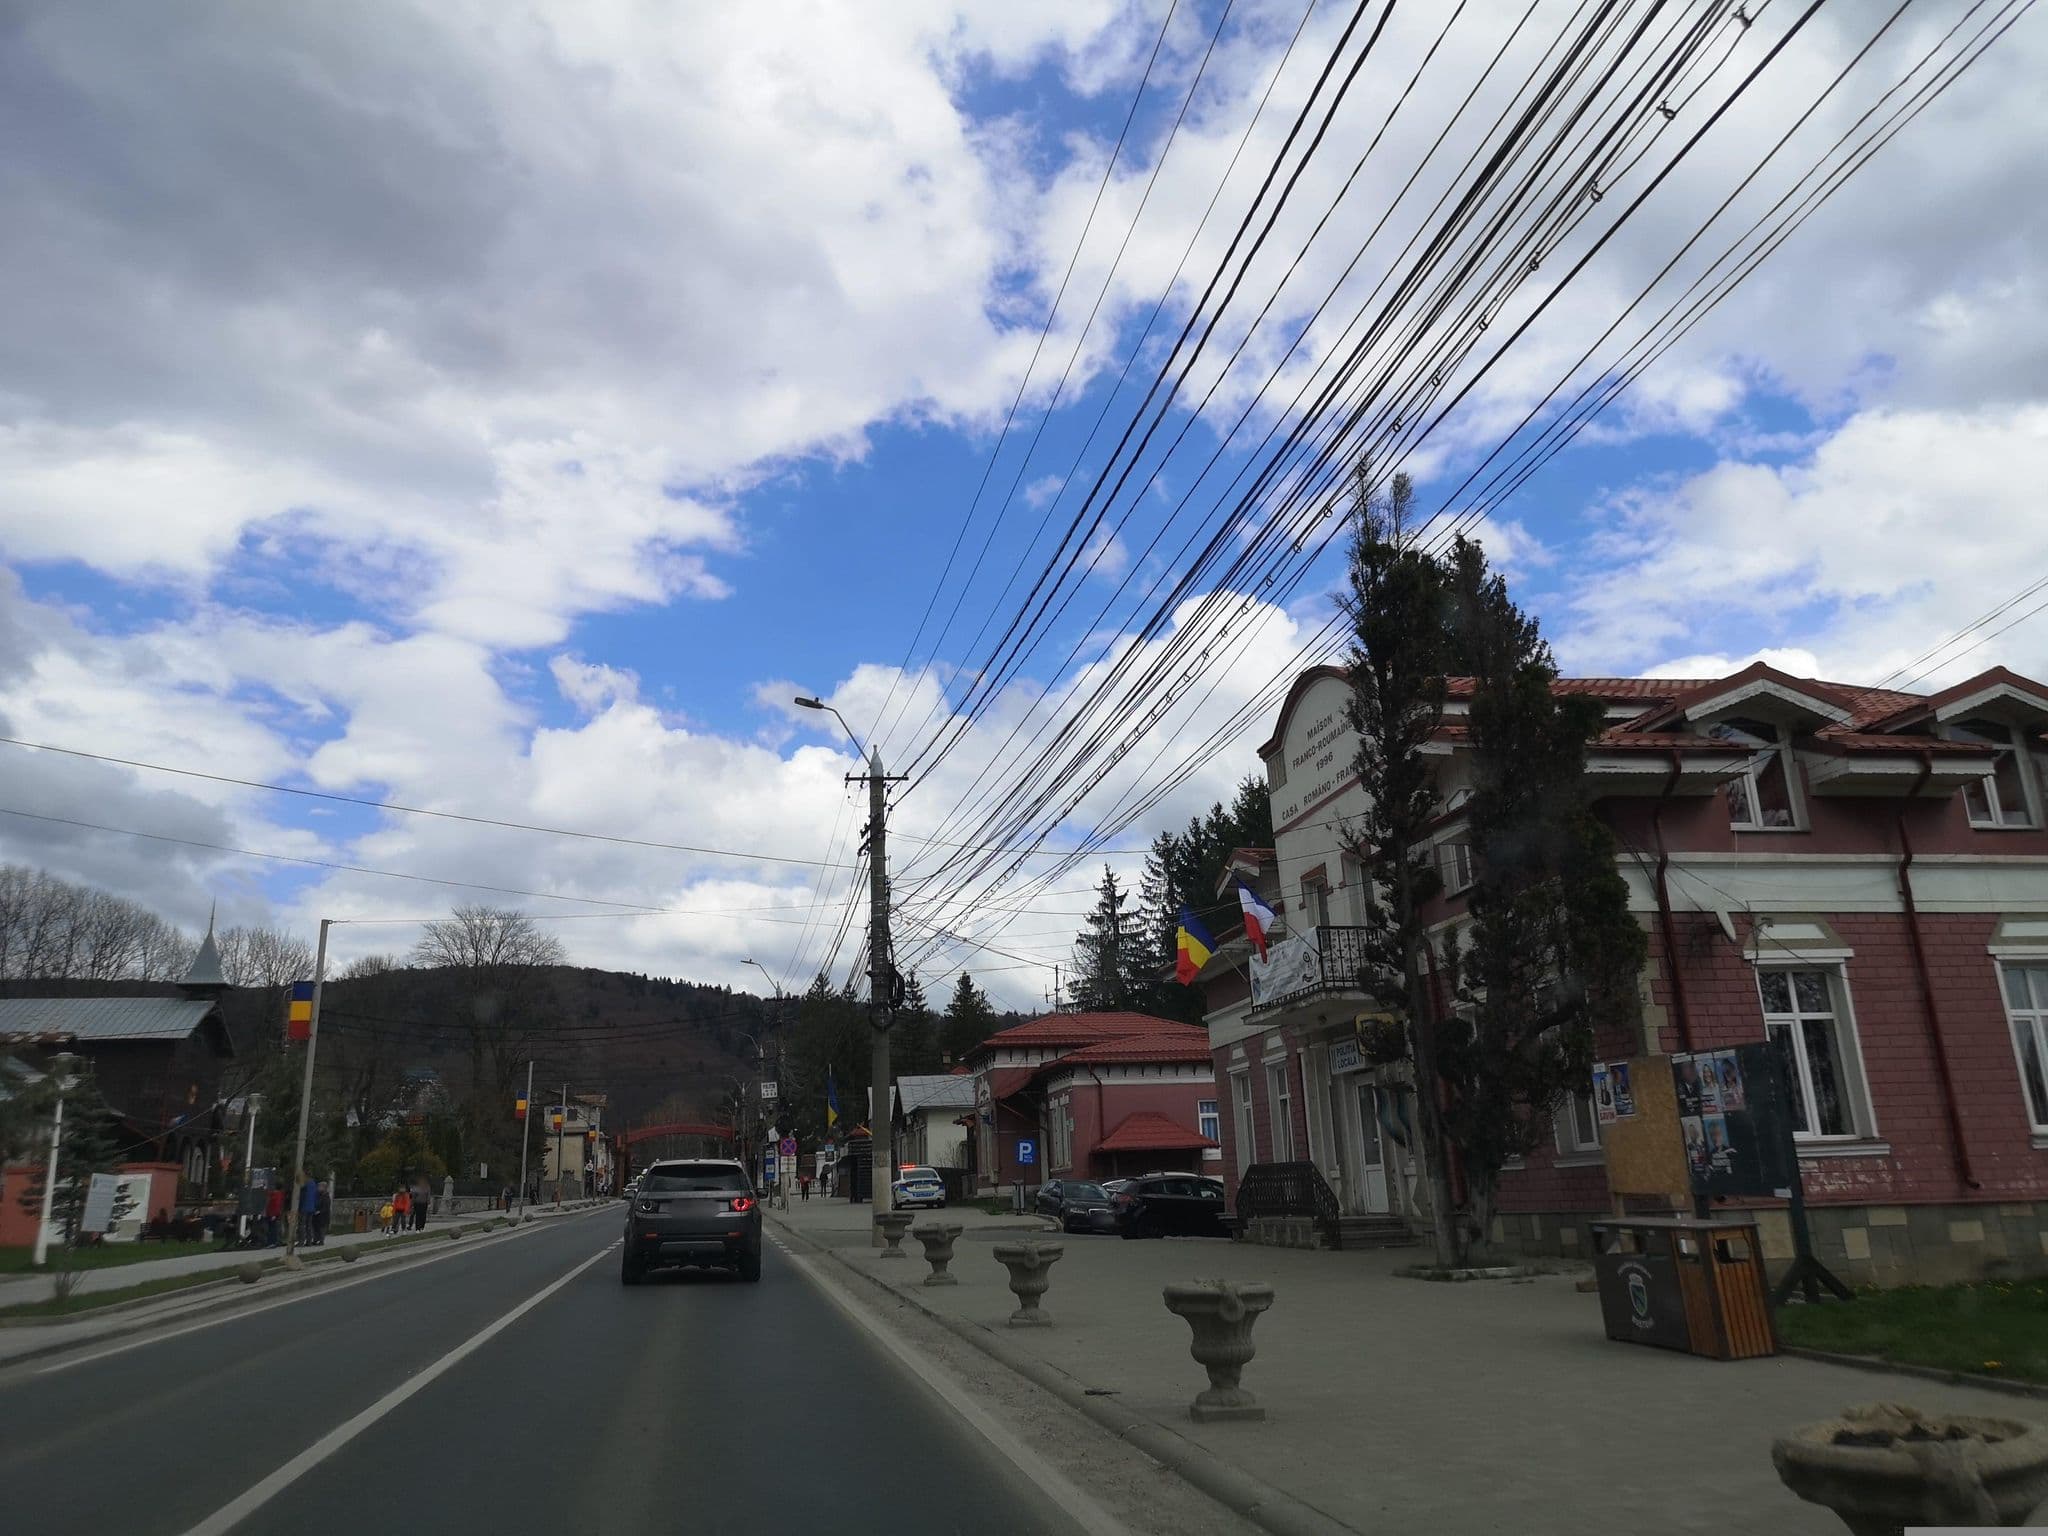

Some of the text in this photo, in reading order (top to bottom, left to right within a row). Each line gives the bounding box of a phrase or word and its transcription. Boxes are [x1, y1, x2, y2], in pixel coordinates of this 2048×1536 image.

[1316, 752, 1334, 771] 1996
[1282, 803, 1299, 821] CASA
[1019, 1142, 1032, 1162] P
